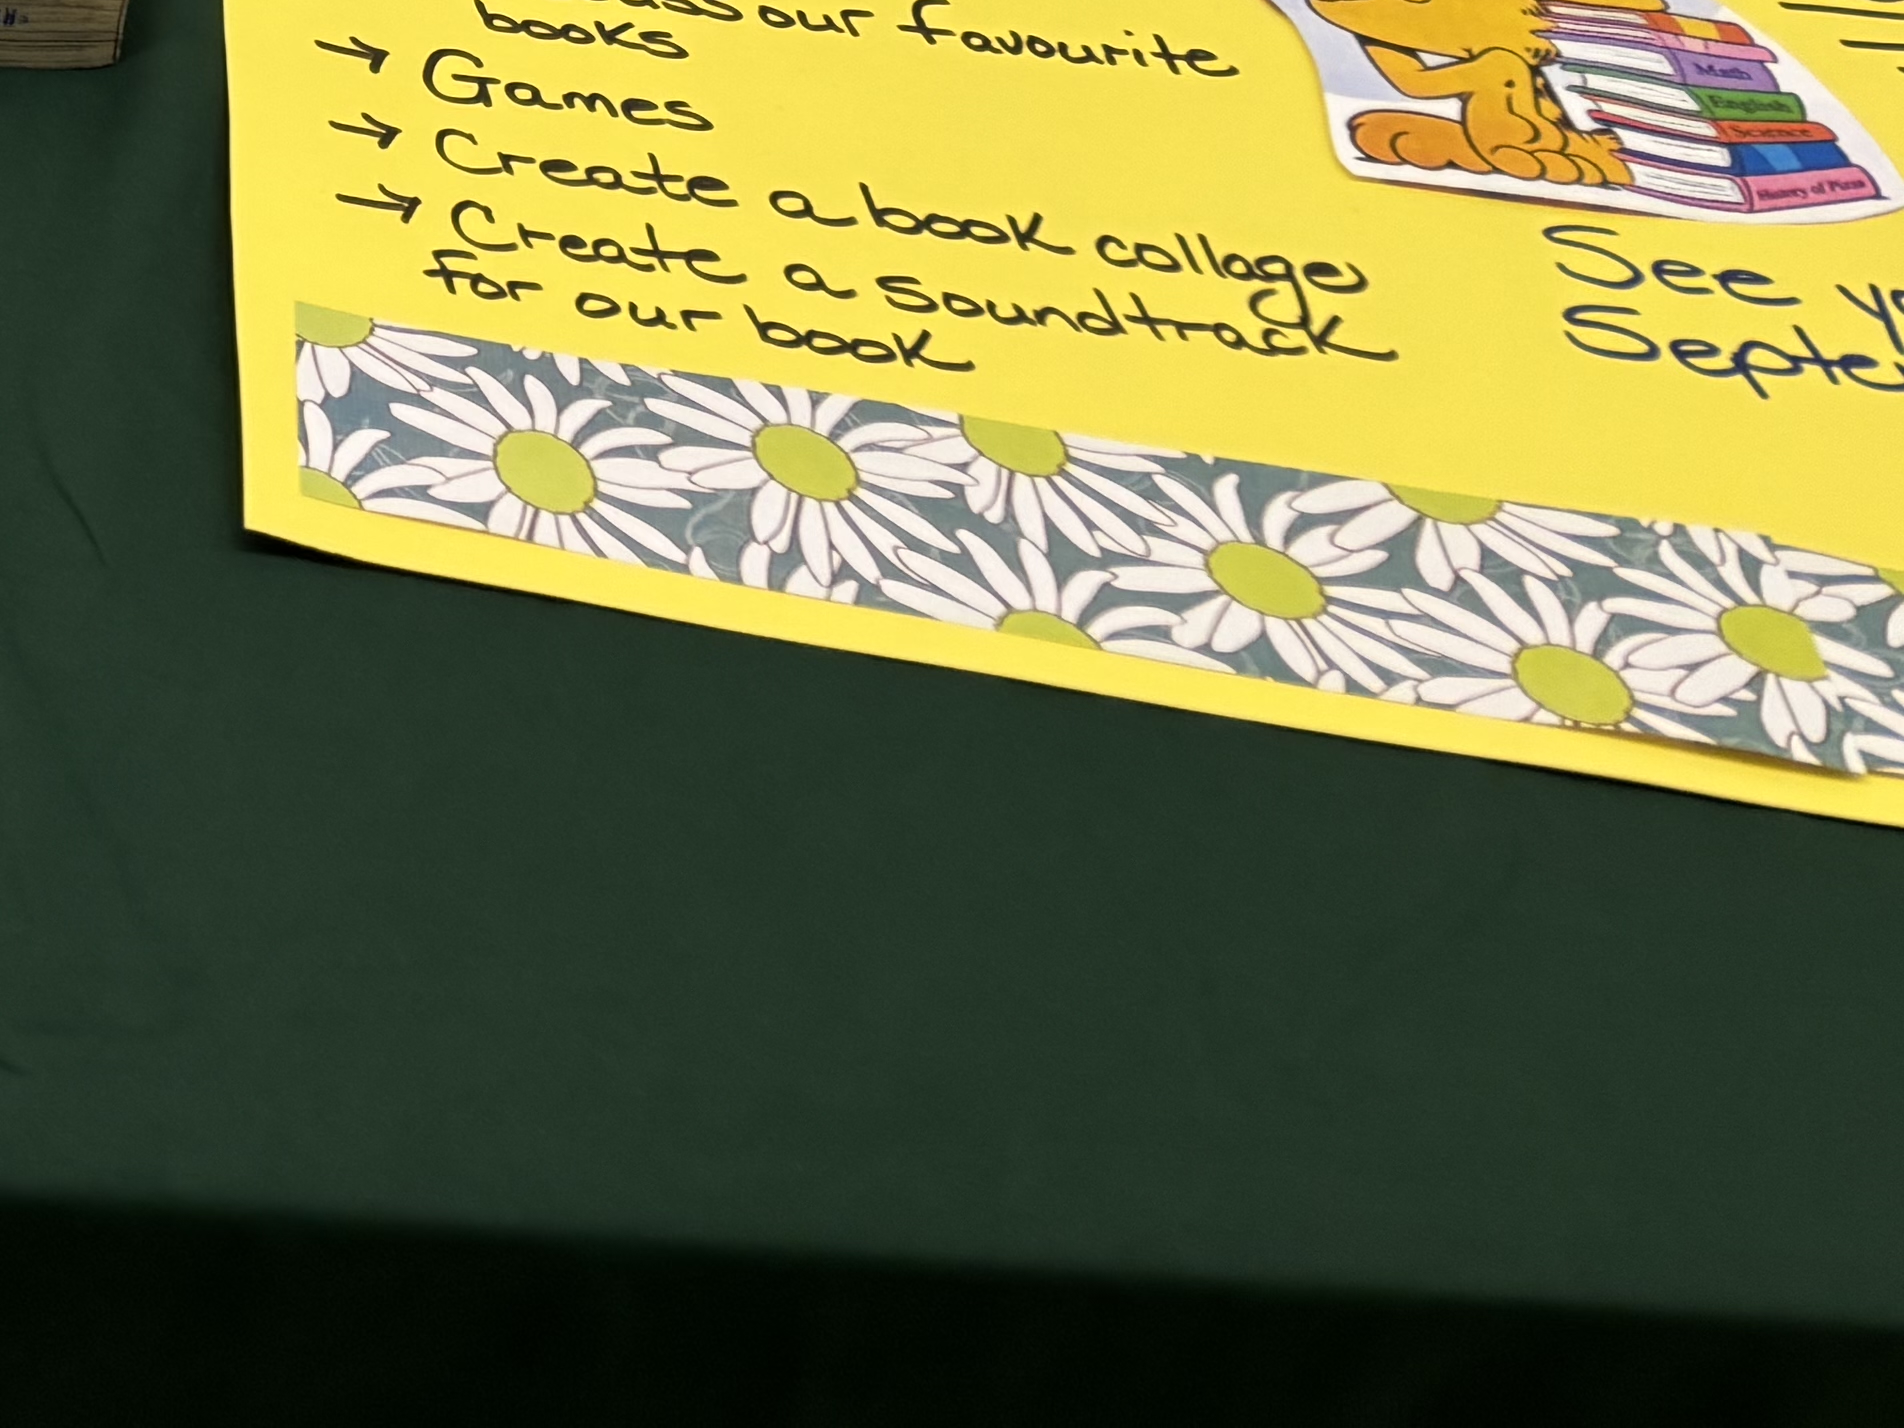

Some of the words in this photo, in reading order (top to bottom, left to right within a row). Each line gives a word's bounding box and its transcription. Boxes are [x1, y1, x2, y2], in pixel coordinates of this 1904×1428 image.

[756, 0, 873, 38] our
[420, 47, 716, 133] Games
[1692, 62, 1754, 82] Math
[1707, 95, 1796, 114] English
[1730, 125, 1814, 139] Science
[433, 126, 740, 208] Create
[768, 188, 858, 228] a
[856, 180, 1075, 259] book
[1094, 232, 1370, 332] collage
[1756, 186, 1809, 202] History
[450, 197, 748, 287] Create
[782, 263, 856, 298] a
[874, 270, 1399, 363] soundtrack
[1541, 223, 1804, 308] See
[423, 246, 546, 303] for
[573, 288, 723, 334] our
[745, 302, 976, 372] book
[1562, 304, 1904, 401] Septe
